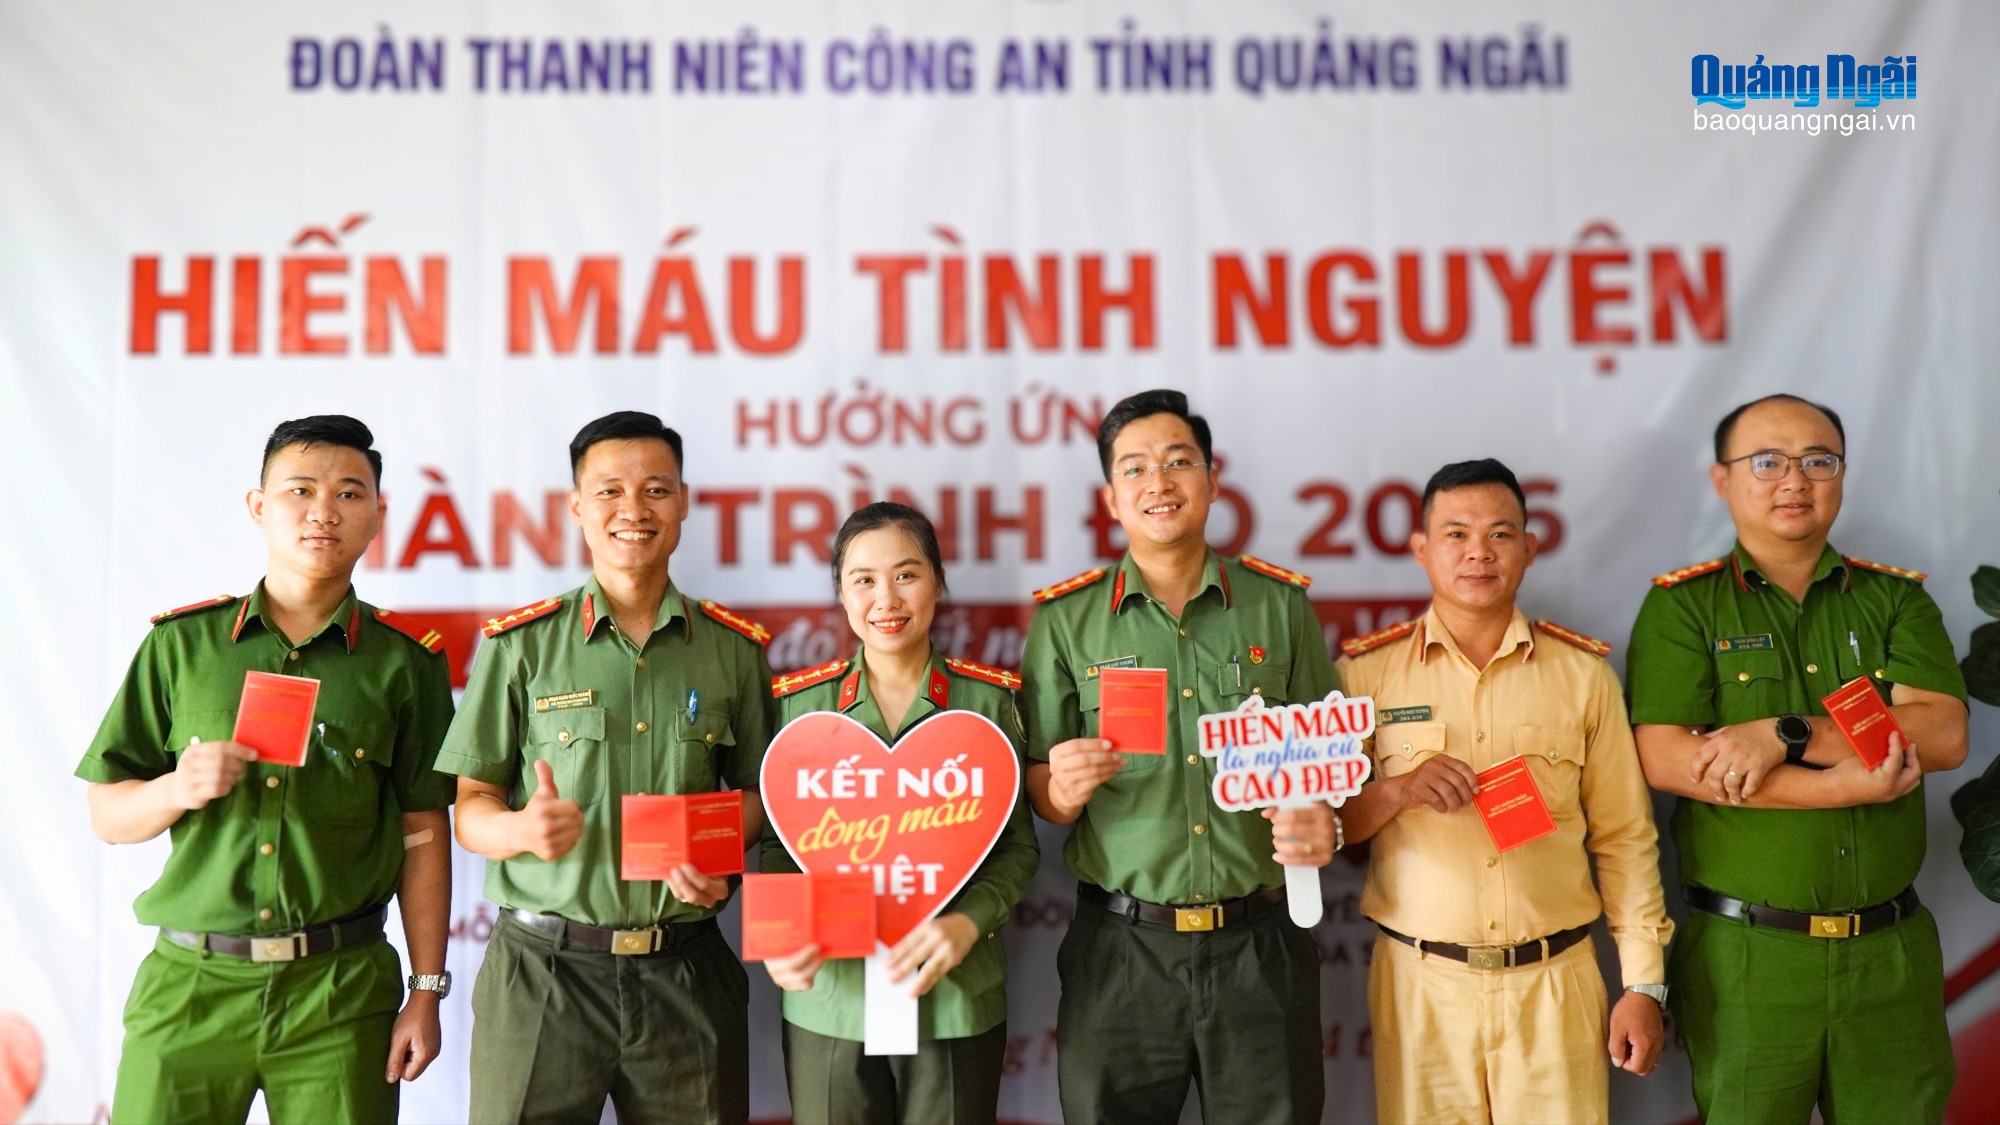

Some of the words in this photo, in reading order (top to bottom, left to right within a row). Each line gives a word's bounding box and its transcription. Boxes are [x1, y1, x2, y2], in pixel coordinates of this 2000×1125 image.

[289, 23, 441, 92] ĐOÀN
[466, 38, 651, 92] THANH
[675, 27, 803, 92] NIÊN
[825, 27, 973, 93] CÔNG
[996, 40, 1068, 92] AN
[1090, 17, 1212, 92] TỈNH
[1235, 17, 1417, 98] QUẢNG
[1441, 23, 1567, 92] NGÃI
[130, 212, 447, 355] HIẾN
[507, 226, 806, 356] MÁU
[855, 225, 1157, 353] TÌNH
[1211, 220, 1729, 374] NGUYỆN
[736, 380, 986, 447] HƯỞNG
[1009, 382, 1104, 447] ỨN
[362, 466, 594, 570] ÀN
[1294, 479, 1564, 558] 206
[1204, 701, 1284, 750] HIẾN
[1293, 697, 1370, 740] MÁU
[796, 754, 885, 799] KẾT
[897, 754, 984, 798] NỐI
[1218, 769, 1293, 805] CAO
[1301, 760, 1365, 801] ĐẸP
[1222, 738, 1247, 770] là
[796, 806, 891, 864] dòng
[898, 788, 983, 834] máu
[836, 854, 944, 905] IỆT
